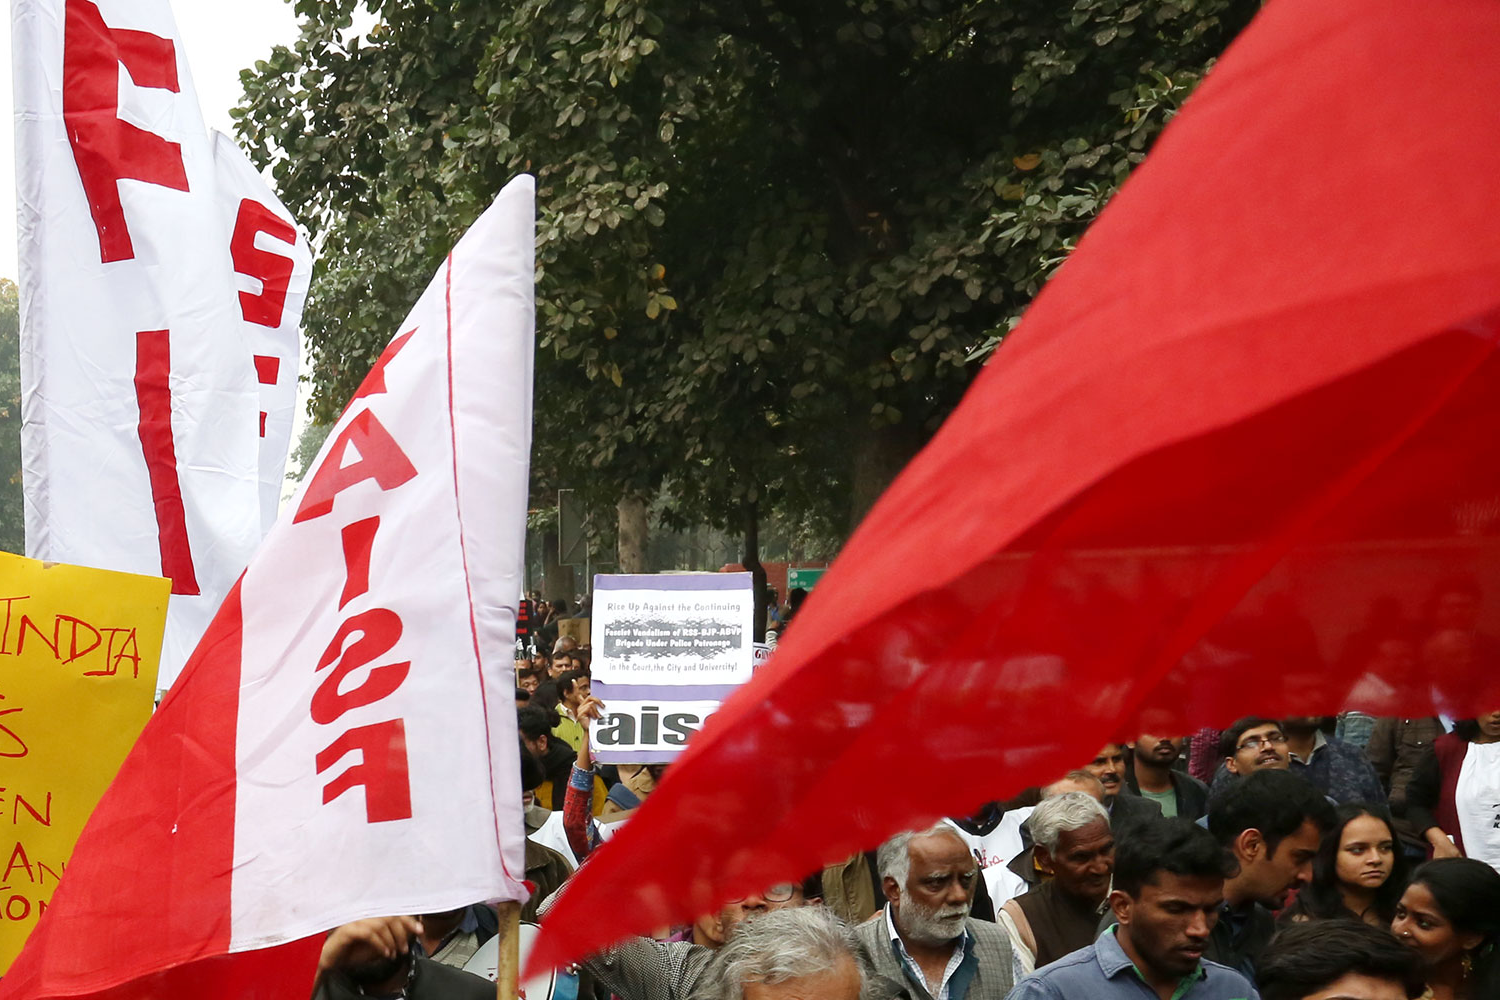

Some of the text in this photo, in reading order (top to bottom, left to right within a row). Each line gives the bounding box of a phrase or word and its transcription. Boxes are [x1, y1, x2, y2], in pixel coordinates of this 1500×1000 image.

[63, 0, 200, 596] FI
[628, 602, 640, 613] Up
[643, 602, 675, 613] Against
[678, 602, 691, 611] the
[694, 602, 741, 613] Continuing
[684, 663, 697, 671] and
[596, 706, 712, 745] ais
[3, 841, 67, 884] AN
